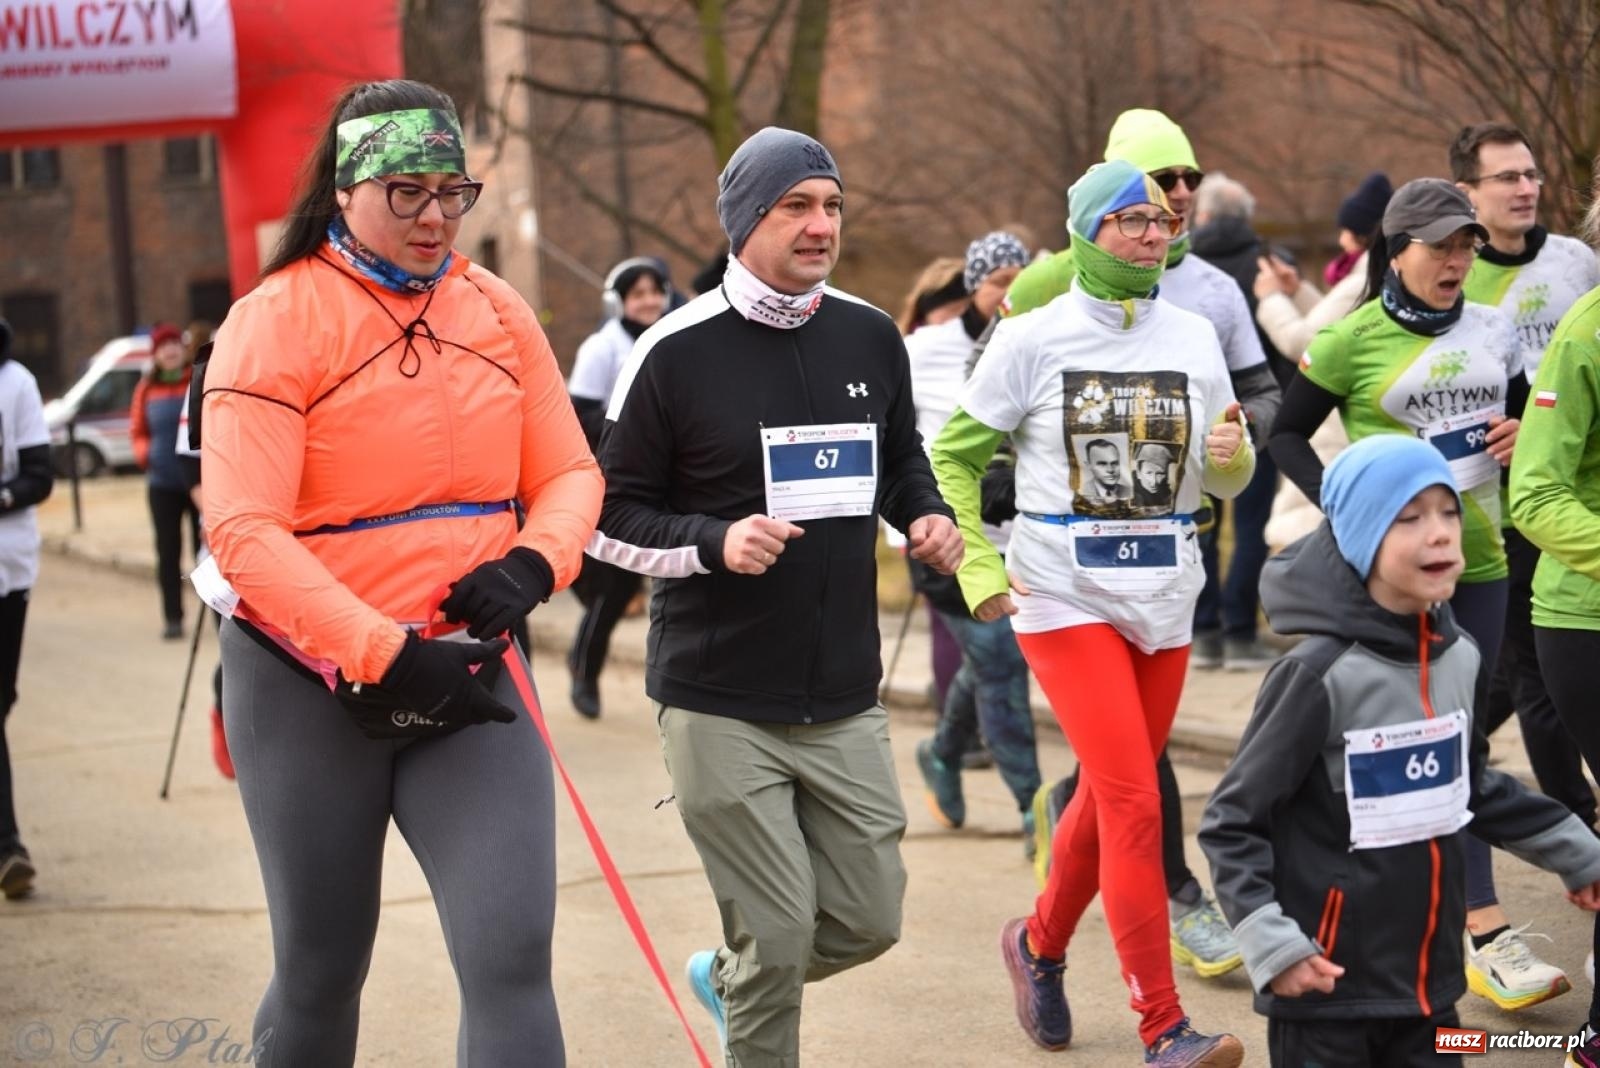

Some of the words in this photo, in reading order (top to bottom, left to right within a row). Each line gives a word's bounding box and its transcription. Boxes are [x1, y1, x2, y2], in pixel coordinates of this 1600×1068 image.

[0, 0, 198, 50] WILCZYM
[1113, 398, 1186, 416] WILCZYM
[1404, 385, 1500, 411] AKTYWNI
[814, 448, 840, 470] 67
[1118, 541, 1139, 560] 61
[1405, 750, 1440, 781] 66
